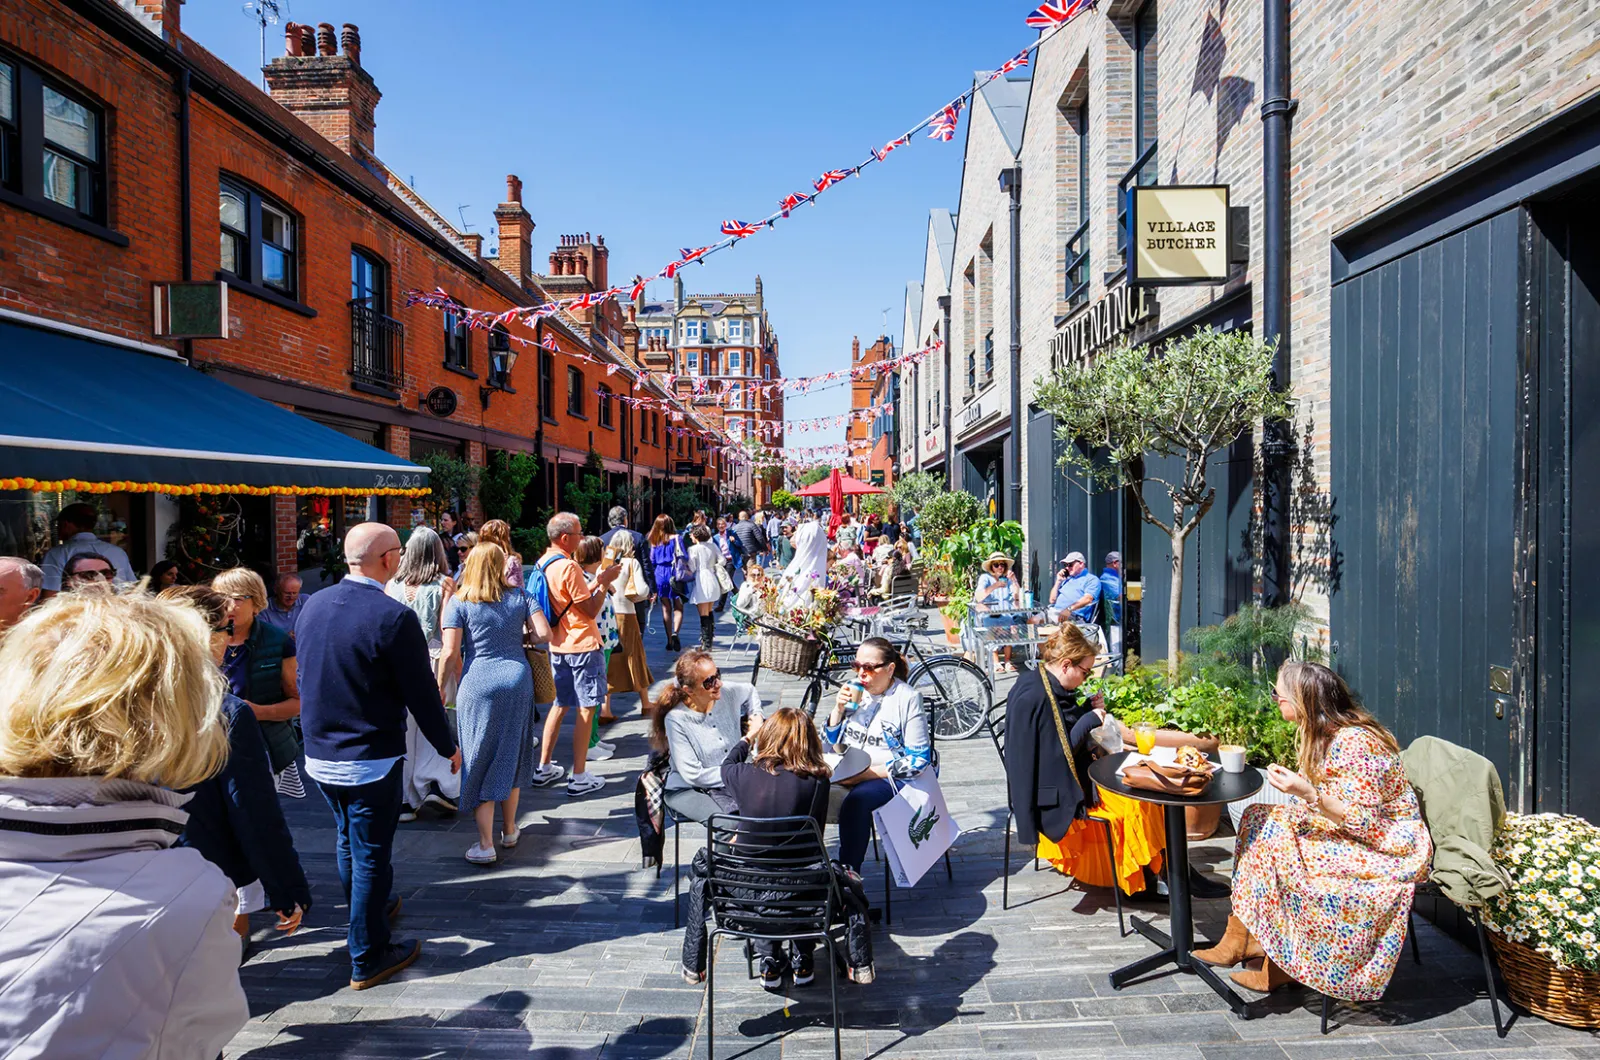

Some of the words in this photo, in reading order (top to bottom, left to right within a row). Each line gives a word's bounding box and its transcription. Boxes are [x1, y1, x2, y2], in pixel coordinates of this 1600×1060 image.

[1147, 221, 1215, 233] VILLAGE
[1147, 238, 1216, 250] BUTCHER
[1048, 280, 1150, 369] PROVENANCE
[845, 726, 883, 746] asper
